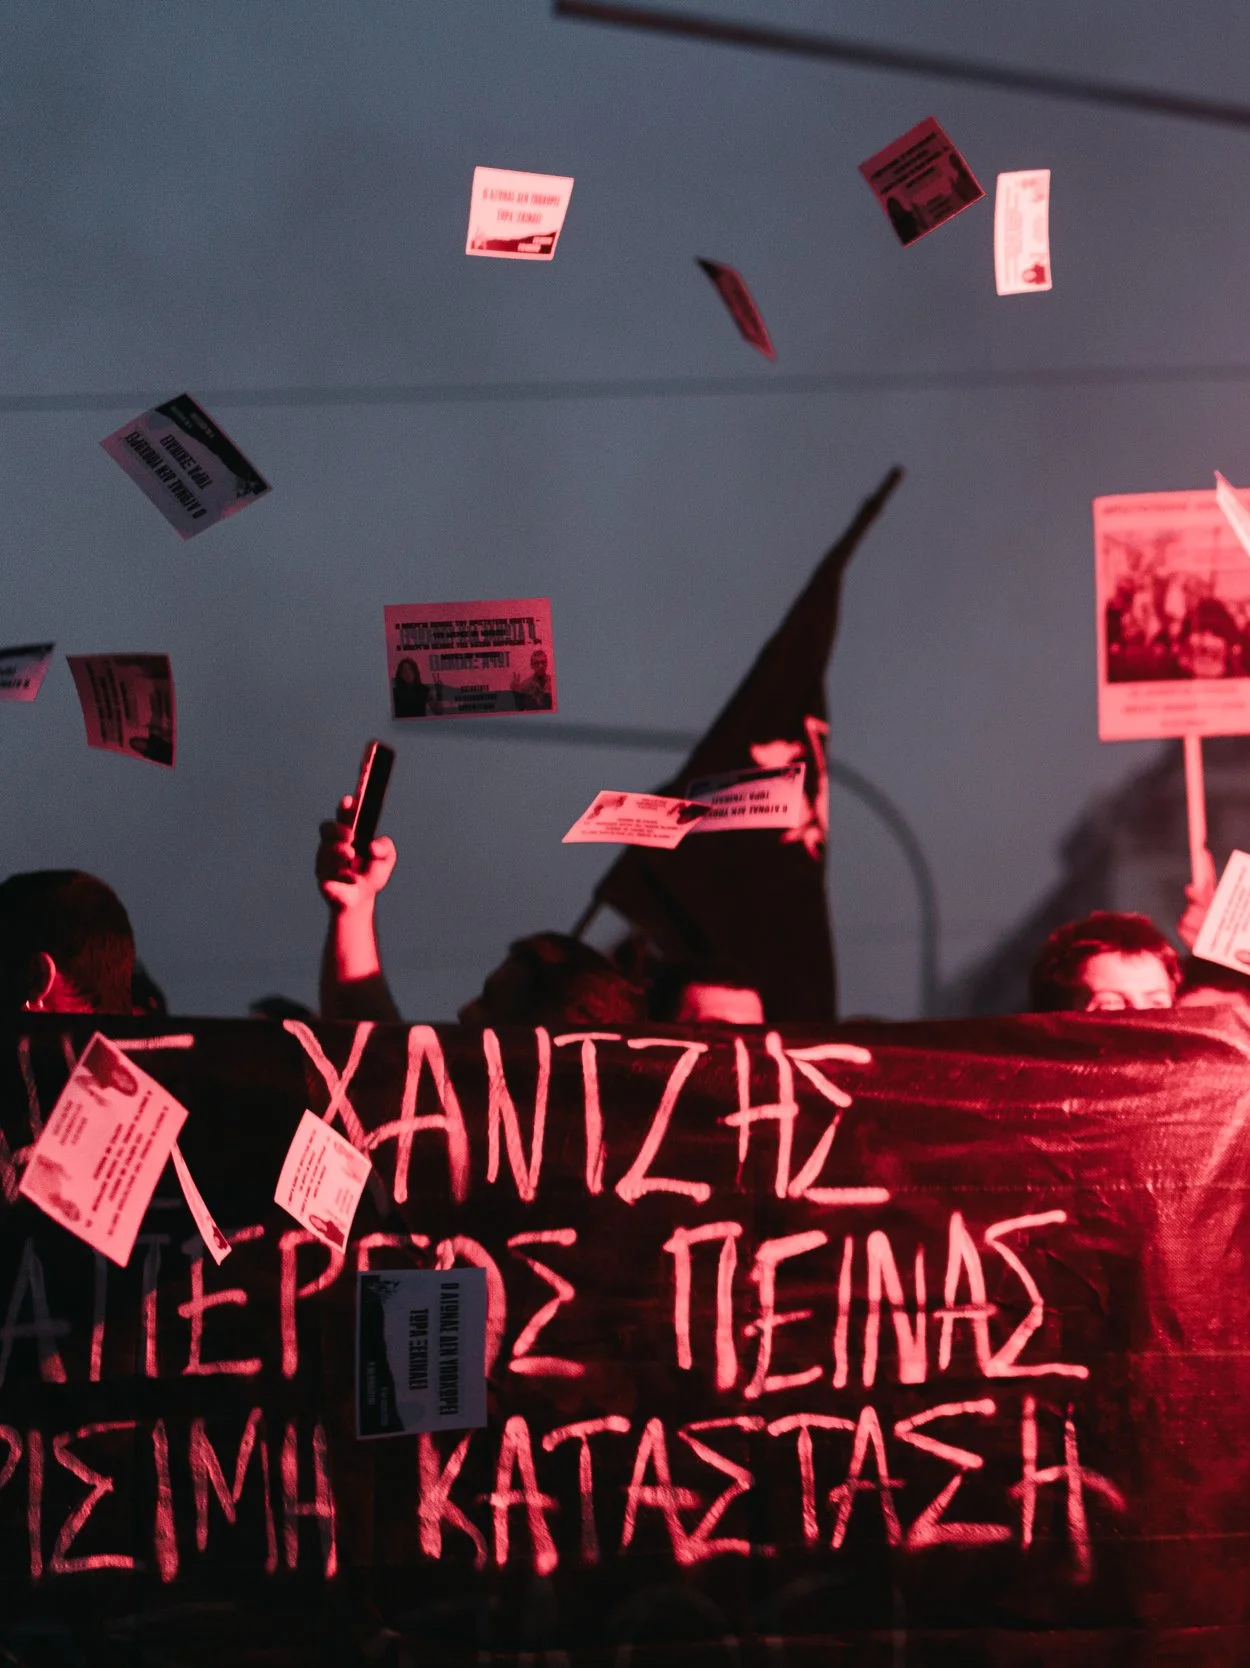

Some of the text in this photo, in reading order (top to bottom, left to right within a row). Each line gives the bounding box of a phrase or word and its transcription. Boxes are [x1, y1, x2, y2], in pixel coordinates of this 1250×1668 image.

[282, 1018, 889, 1206] ΧΑΝΤΖΗΣ
[440, 1293, 459, 1333] ΑΓΩΝΑΣ
[664, 1210, 1090, 1399] ΠΕΙΝΑΣ
[409, 1309, 428, 1390] ΤΩΡΑ ΞΕΚΙΝΑΕΙ
[440, 1336, 459, 1356] ΔΕΝ
[439, 1359, 459, 1416] ΥΠΟΧΩΡΕΙ
[418, 1396, 1128, 1586] ΚΑΤΑΣΤΑΣΗ
